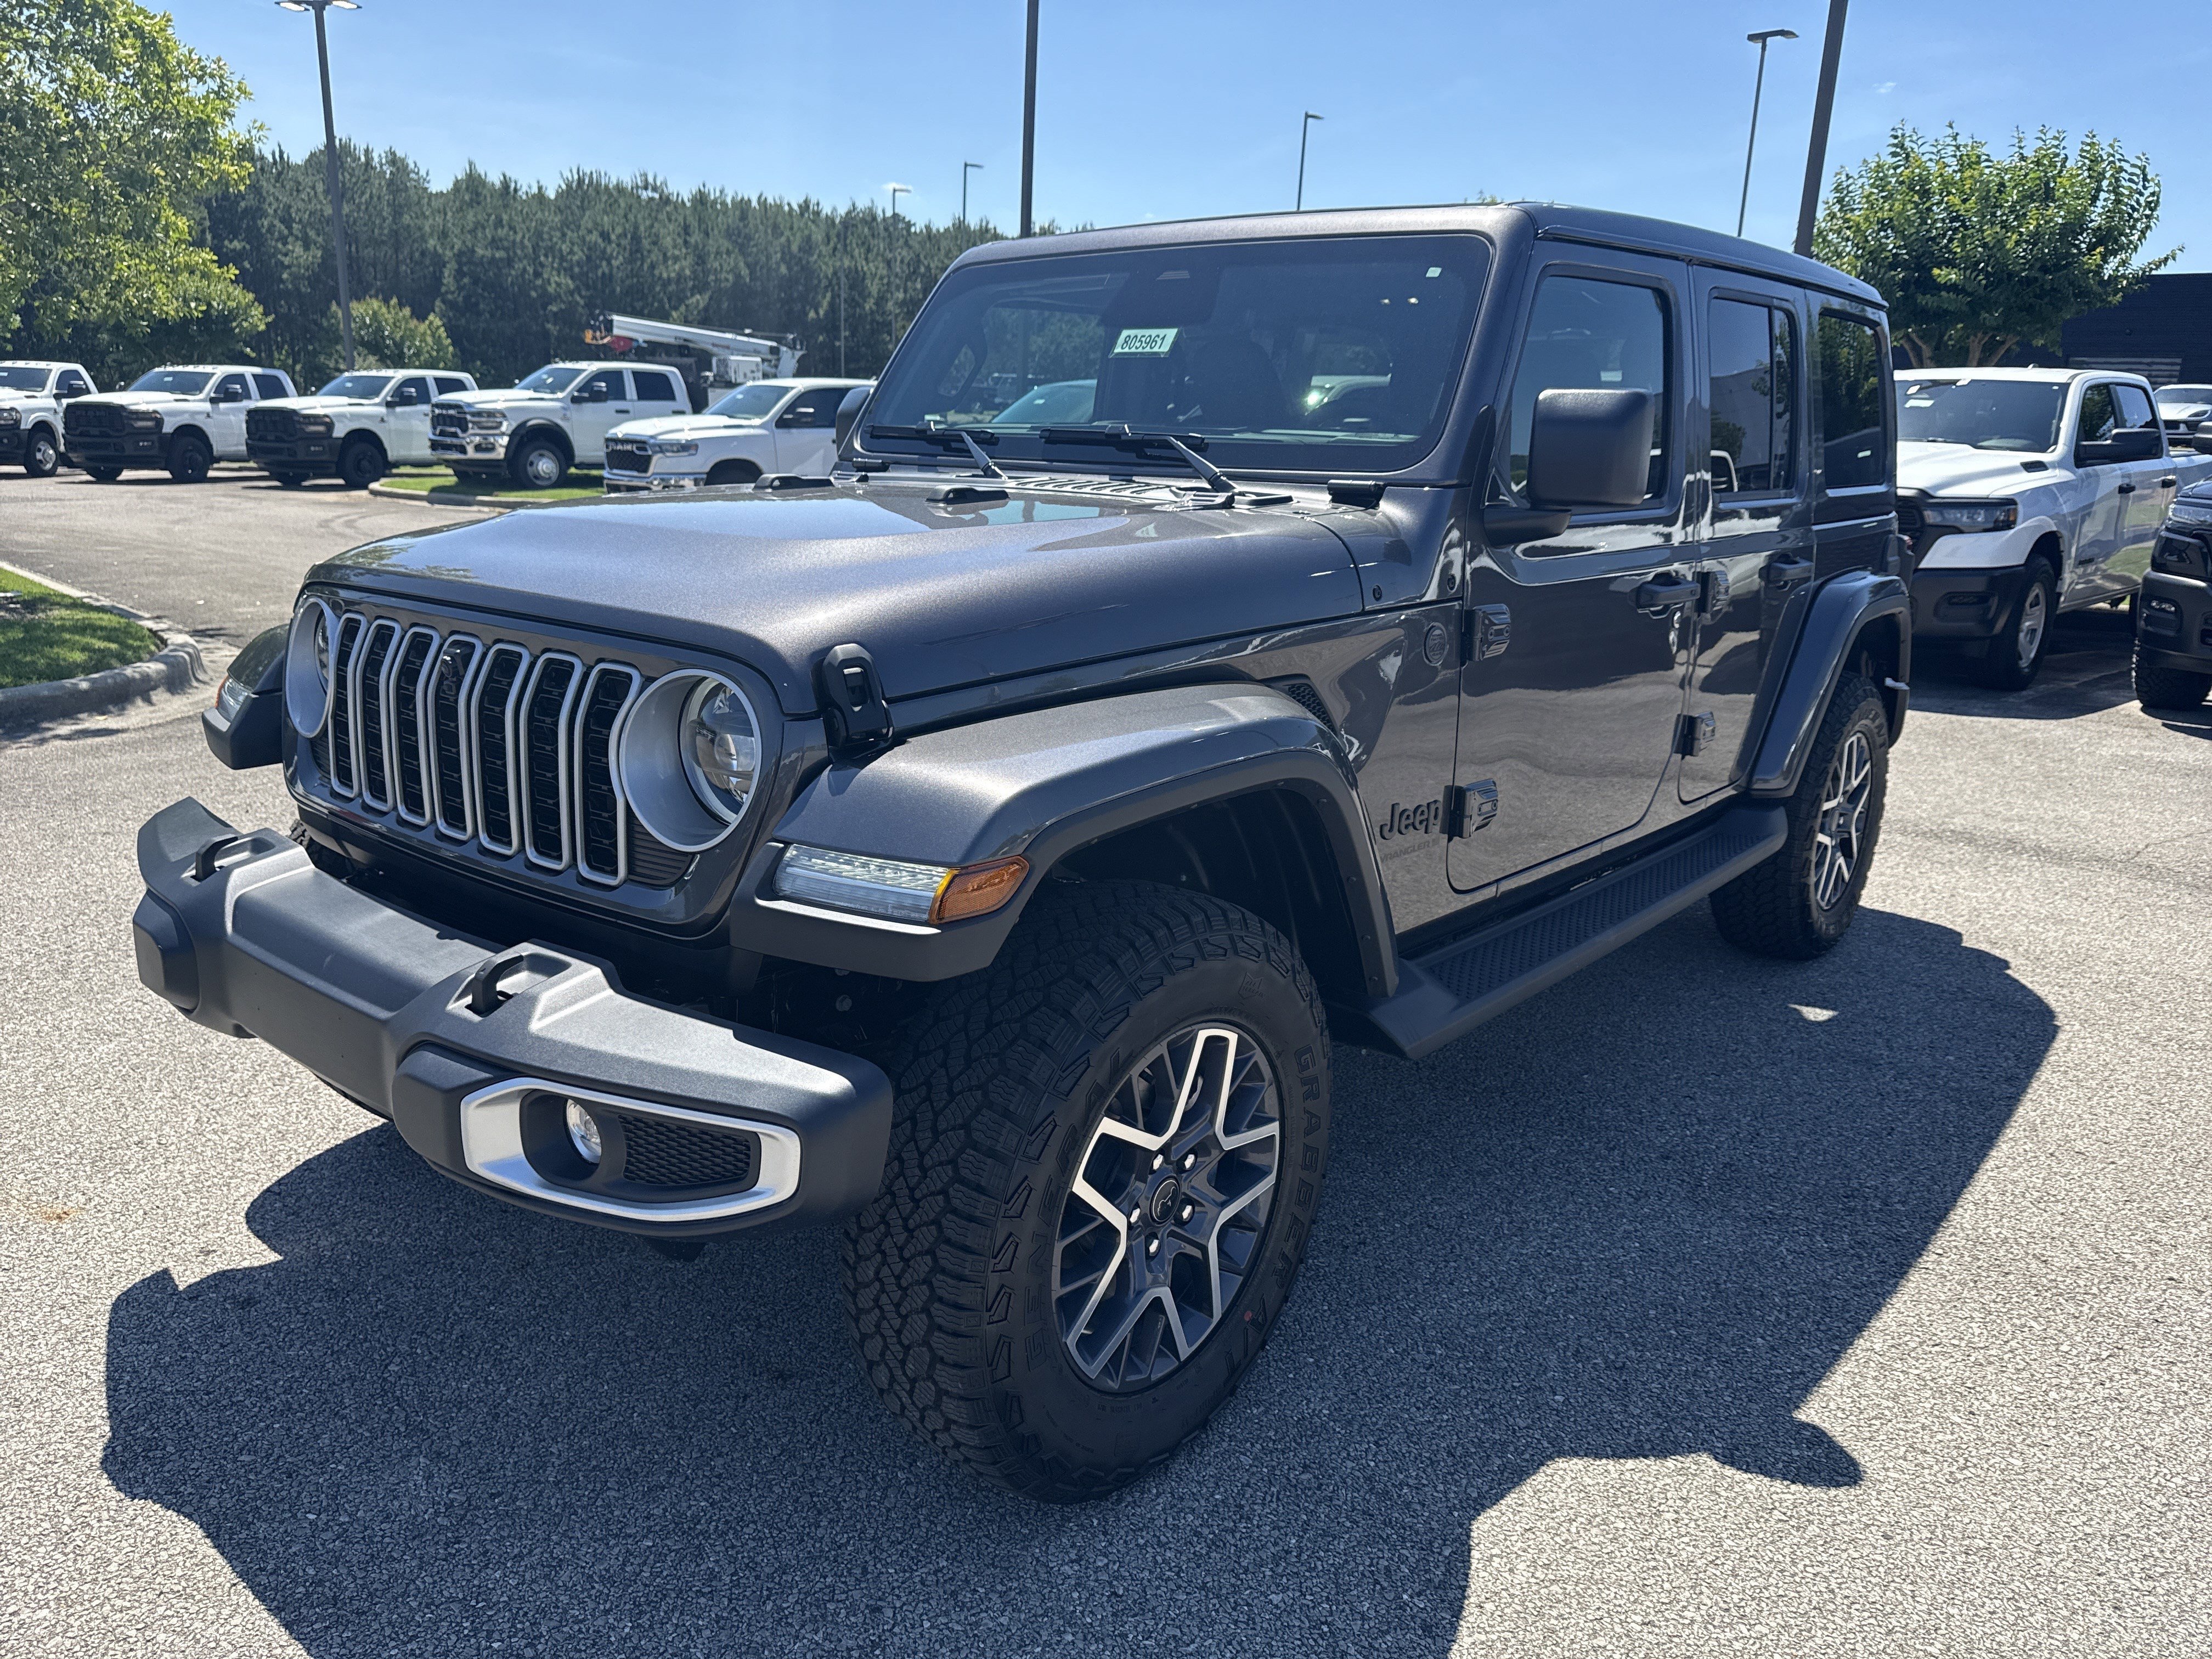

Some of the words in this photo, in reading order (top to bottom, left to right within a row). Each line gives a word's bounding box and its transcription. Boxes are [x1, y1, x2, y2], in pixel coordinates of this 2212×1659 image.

[1121, 334, 1167, 350] 805961
[609, 441, 633, 452] RAM
[1379, 799, 1443, 840] Jeep
[1380, 840, 1431, 862] WRANGLER
[1271, 1045, 1321, 1289] GRABBER
[1024, 1047, 1122, 1372] GENERAL
